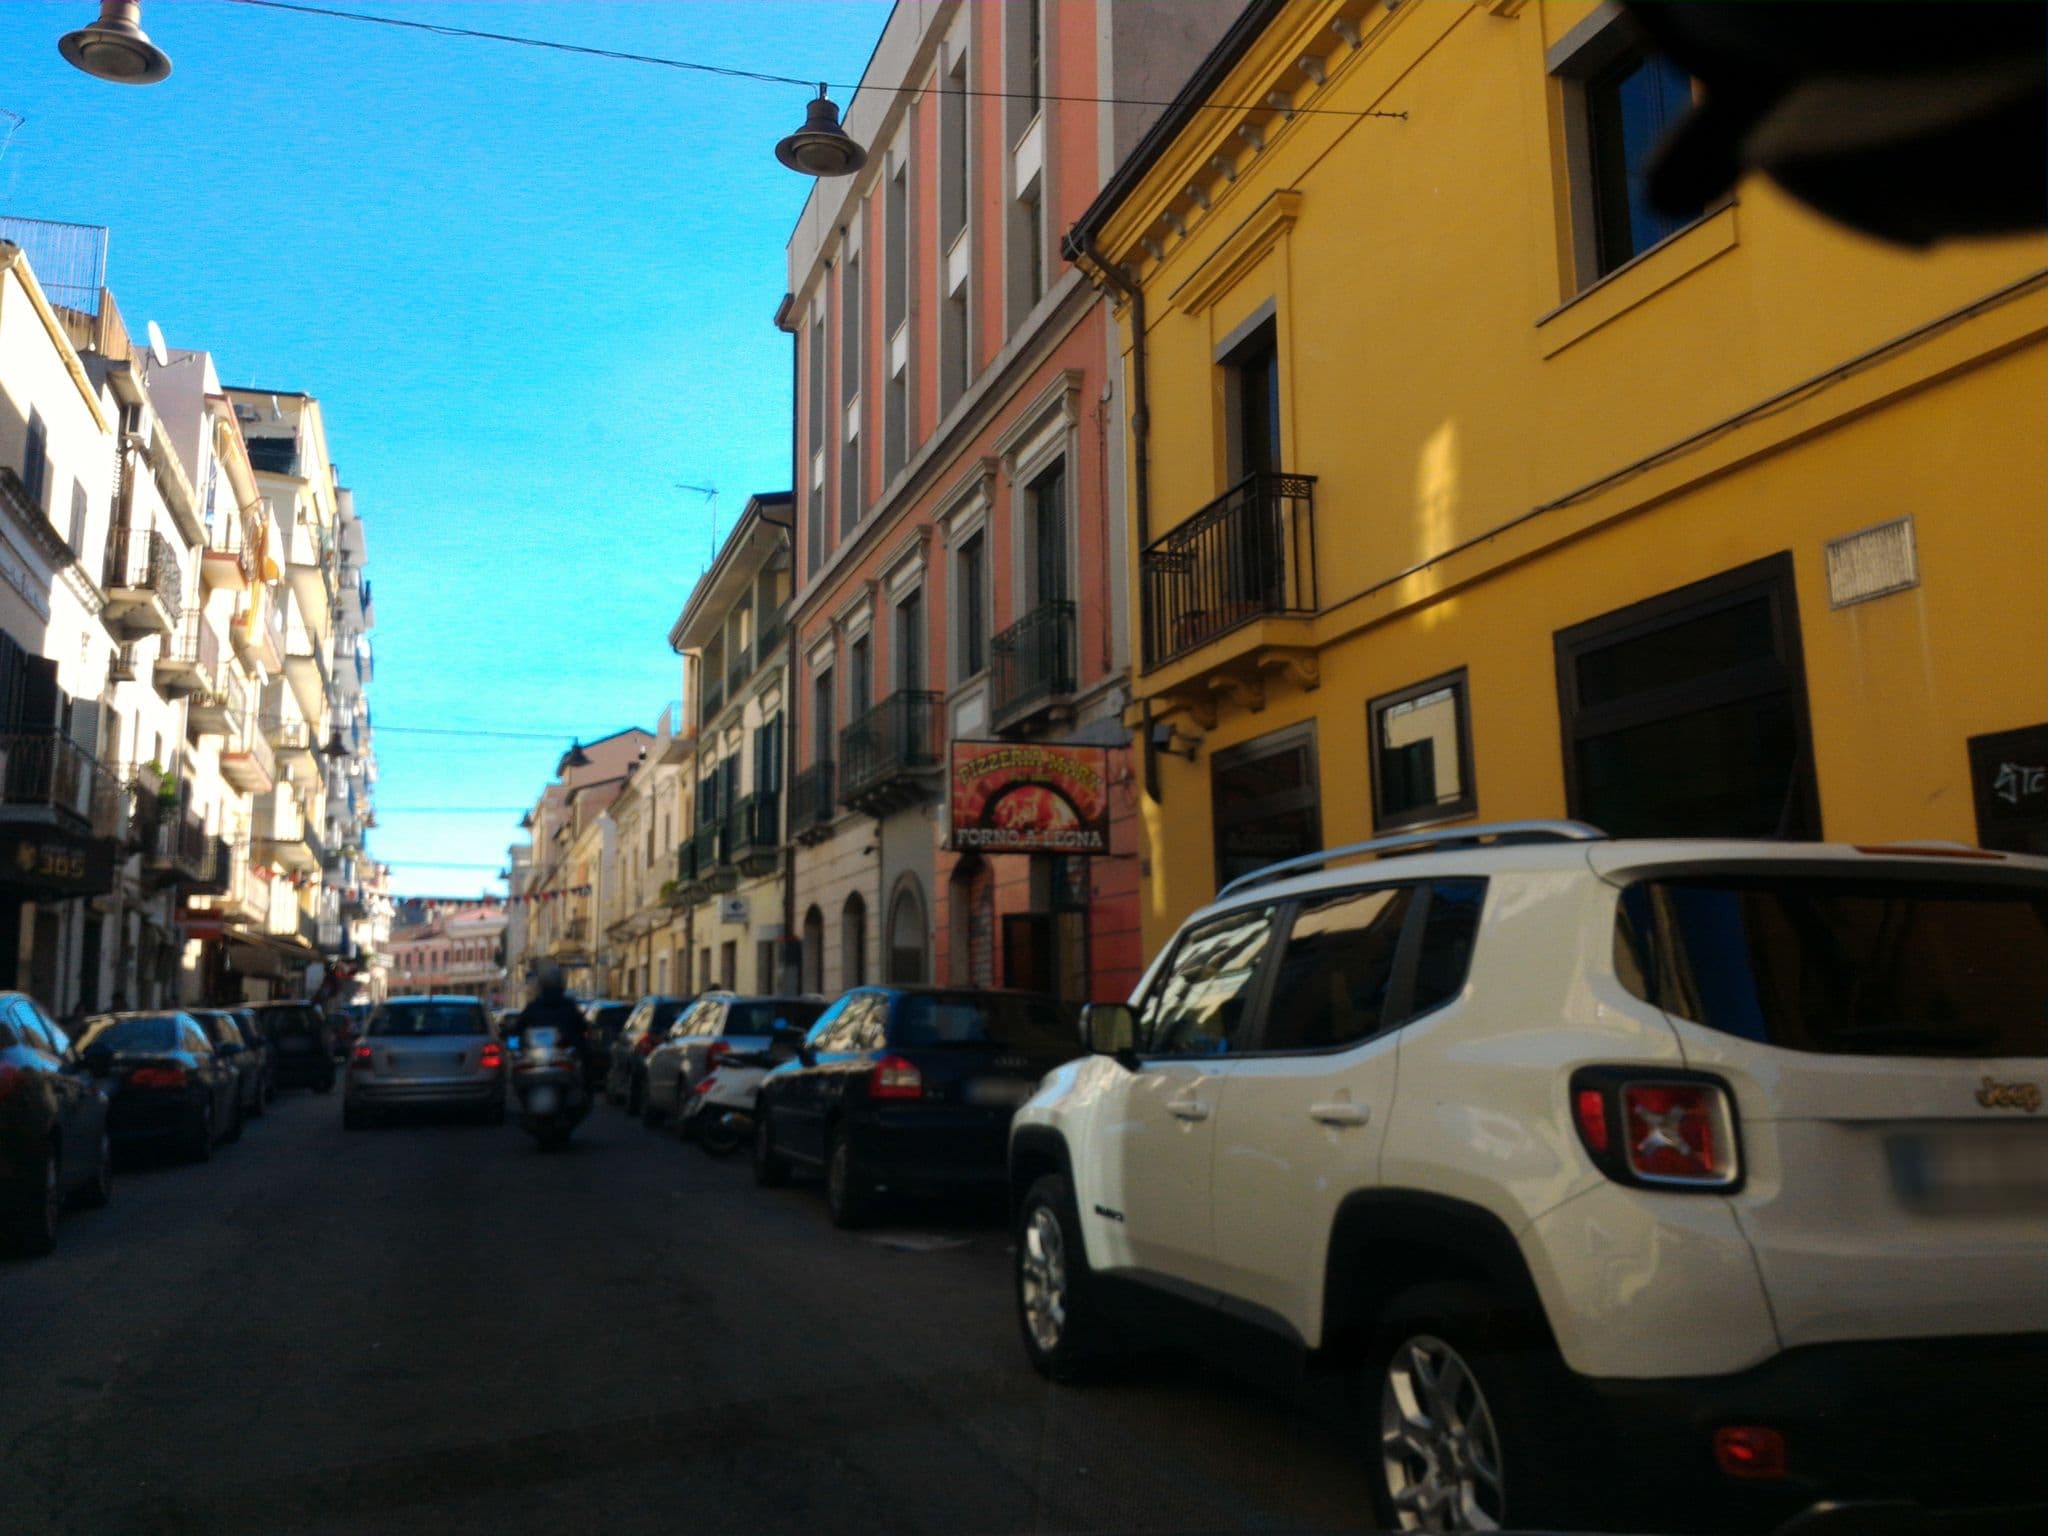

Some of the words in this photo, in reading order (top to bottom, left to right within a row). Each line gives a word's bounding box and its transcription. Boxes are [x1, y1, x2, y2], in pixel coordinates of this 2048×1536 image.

[958, 745, 1042, 785] PIZZERIA
[956, 828, 1019, 846] FORNO
[1025, 828, 1038, 846] A
[1042, 829, 1103, 847] LEGNA
[1973, 1076, 2042, 1112] Jeep
